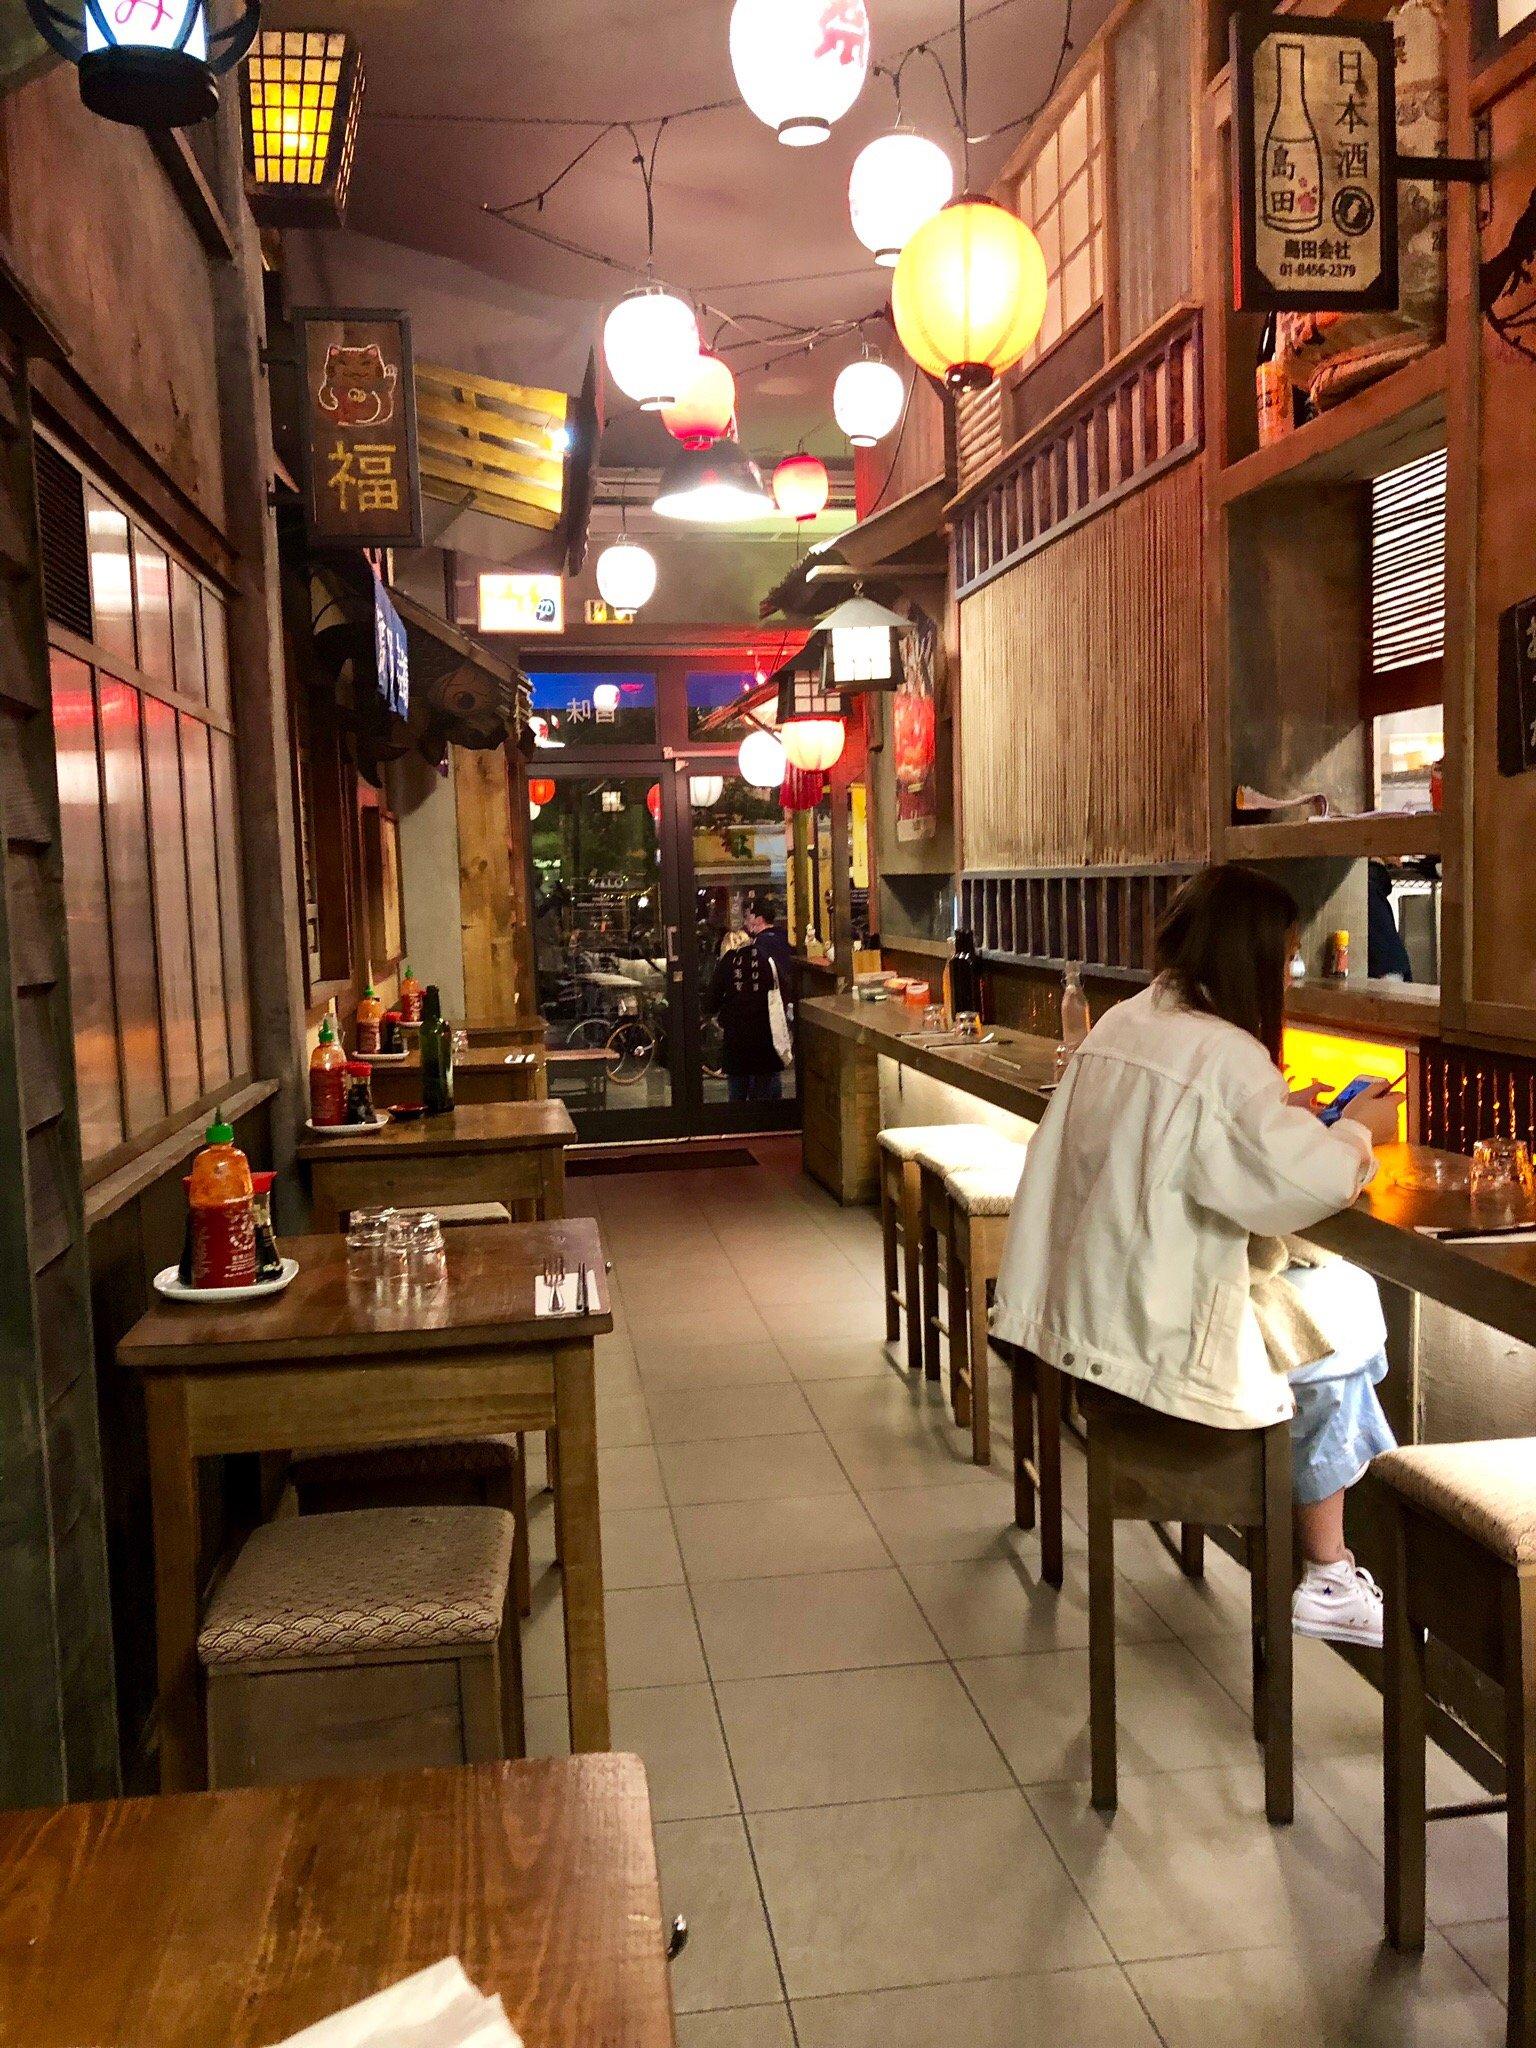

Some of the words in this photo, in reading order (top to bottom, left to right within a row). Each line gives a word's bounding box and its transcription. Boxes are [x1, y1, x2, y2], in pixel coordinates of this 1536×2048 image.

[1334, 49, 1369, 179] 日本酒
[328, 440, 399, 512] 福
